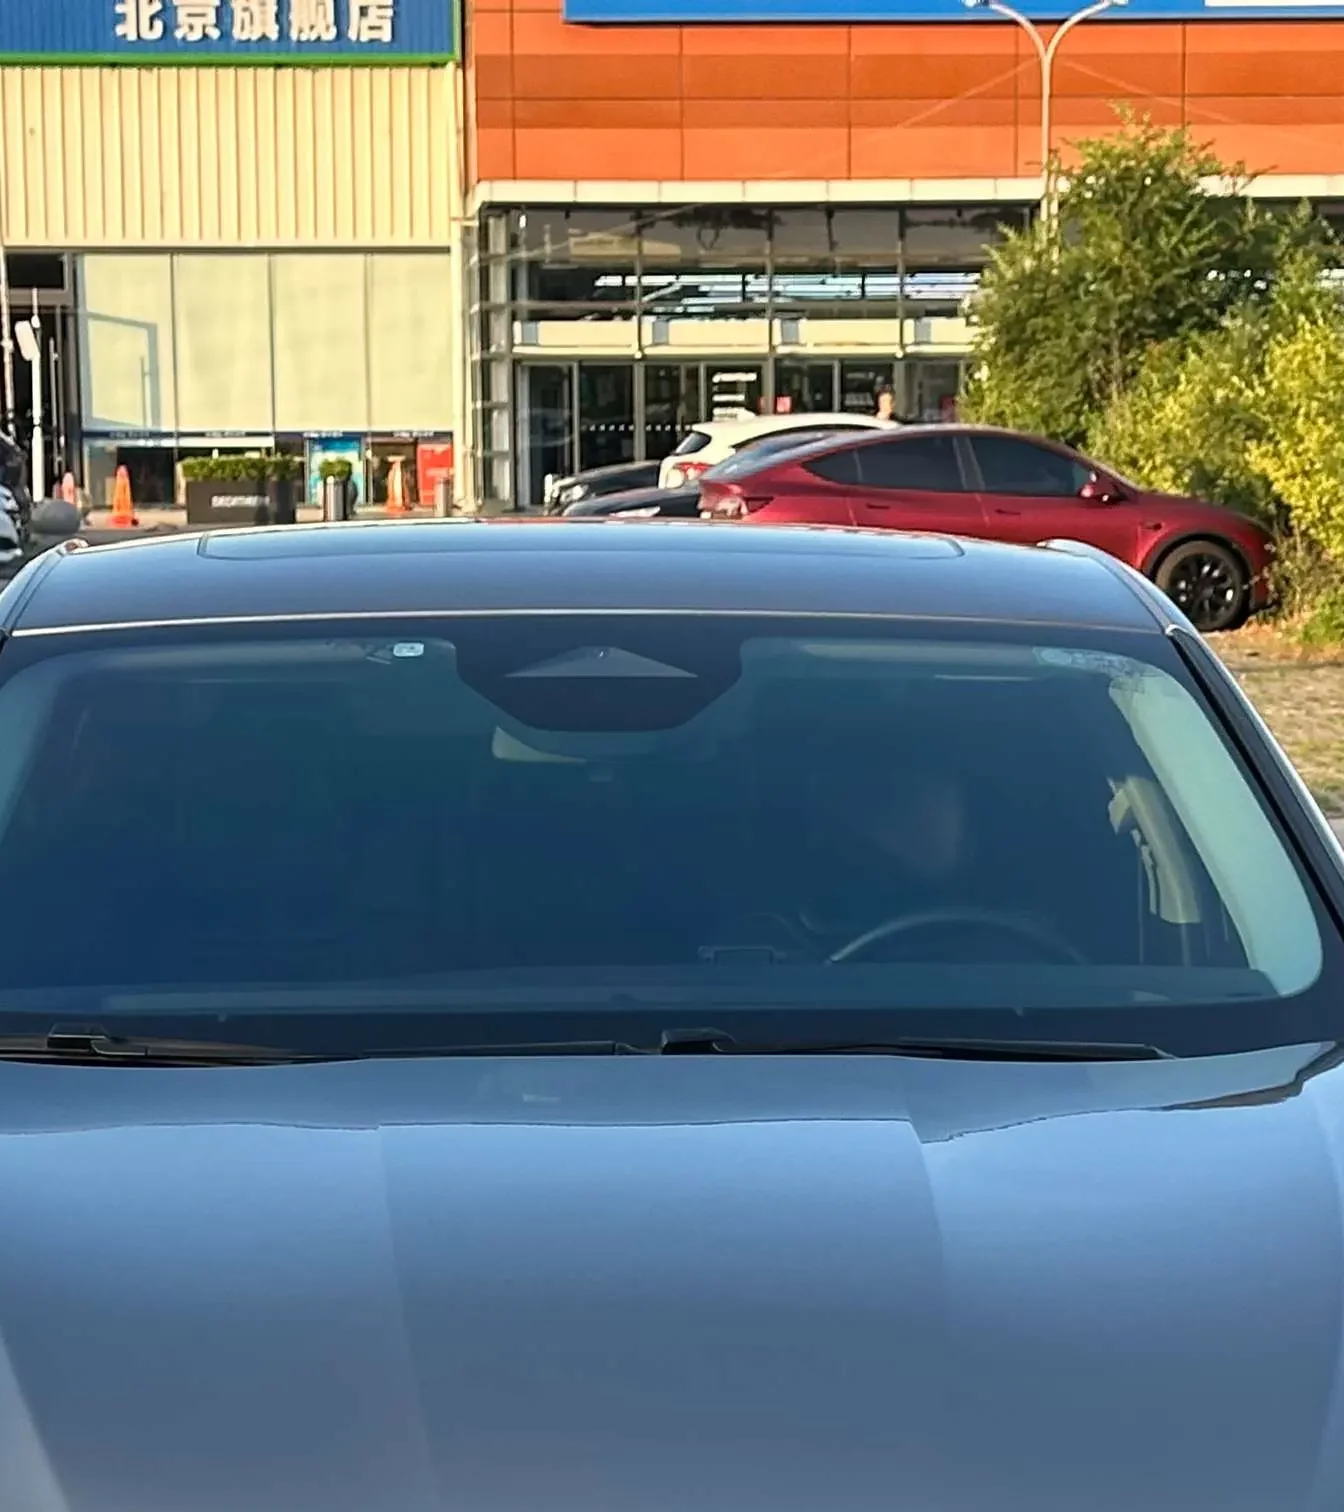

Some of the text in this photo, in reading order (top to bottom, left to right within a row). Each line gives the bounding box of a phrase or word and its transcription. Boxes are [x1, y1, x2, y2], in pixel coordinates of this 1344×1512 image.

[115, 0, 394, 41] 北京旗舰店
